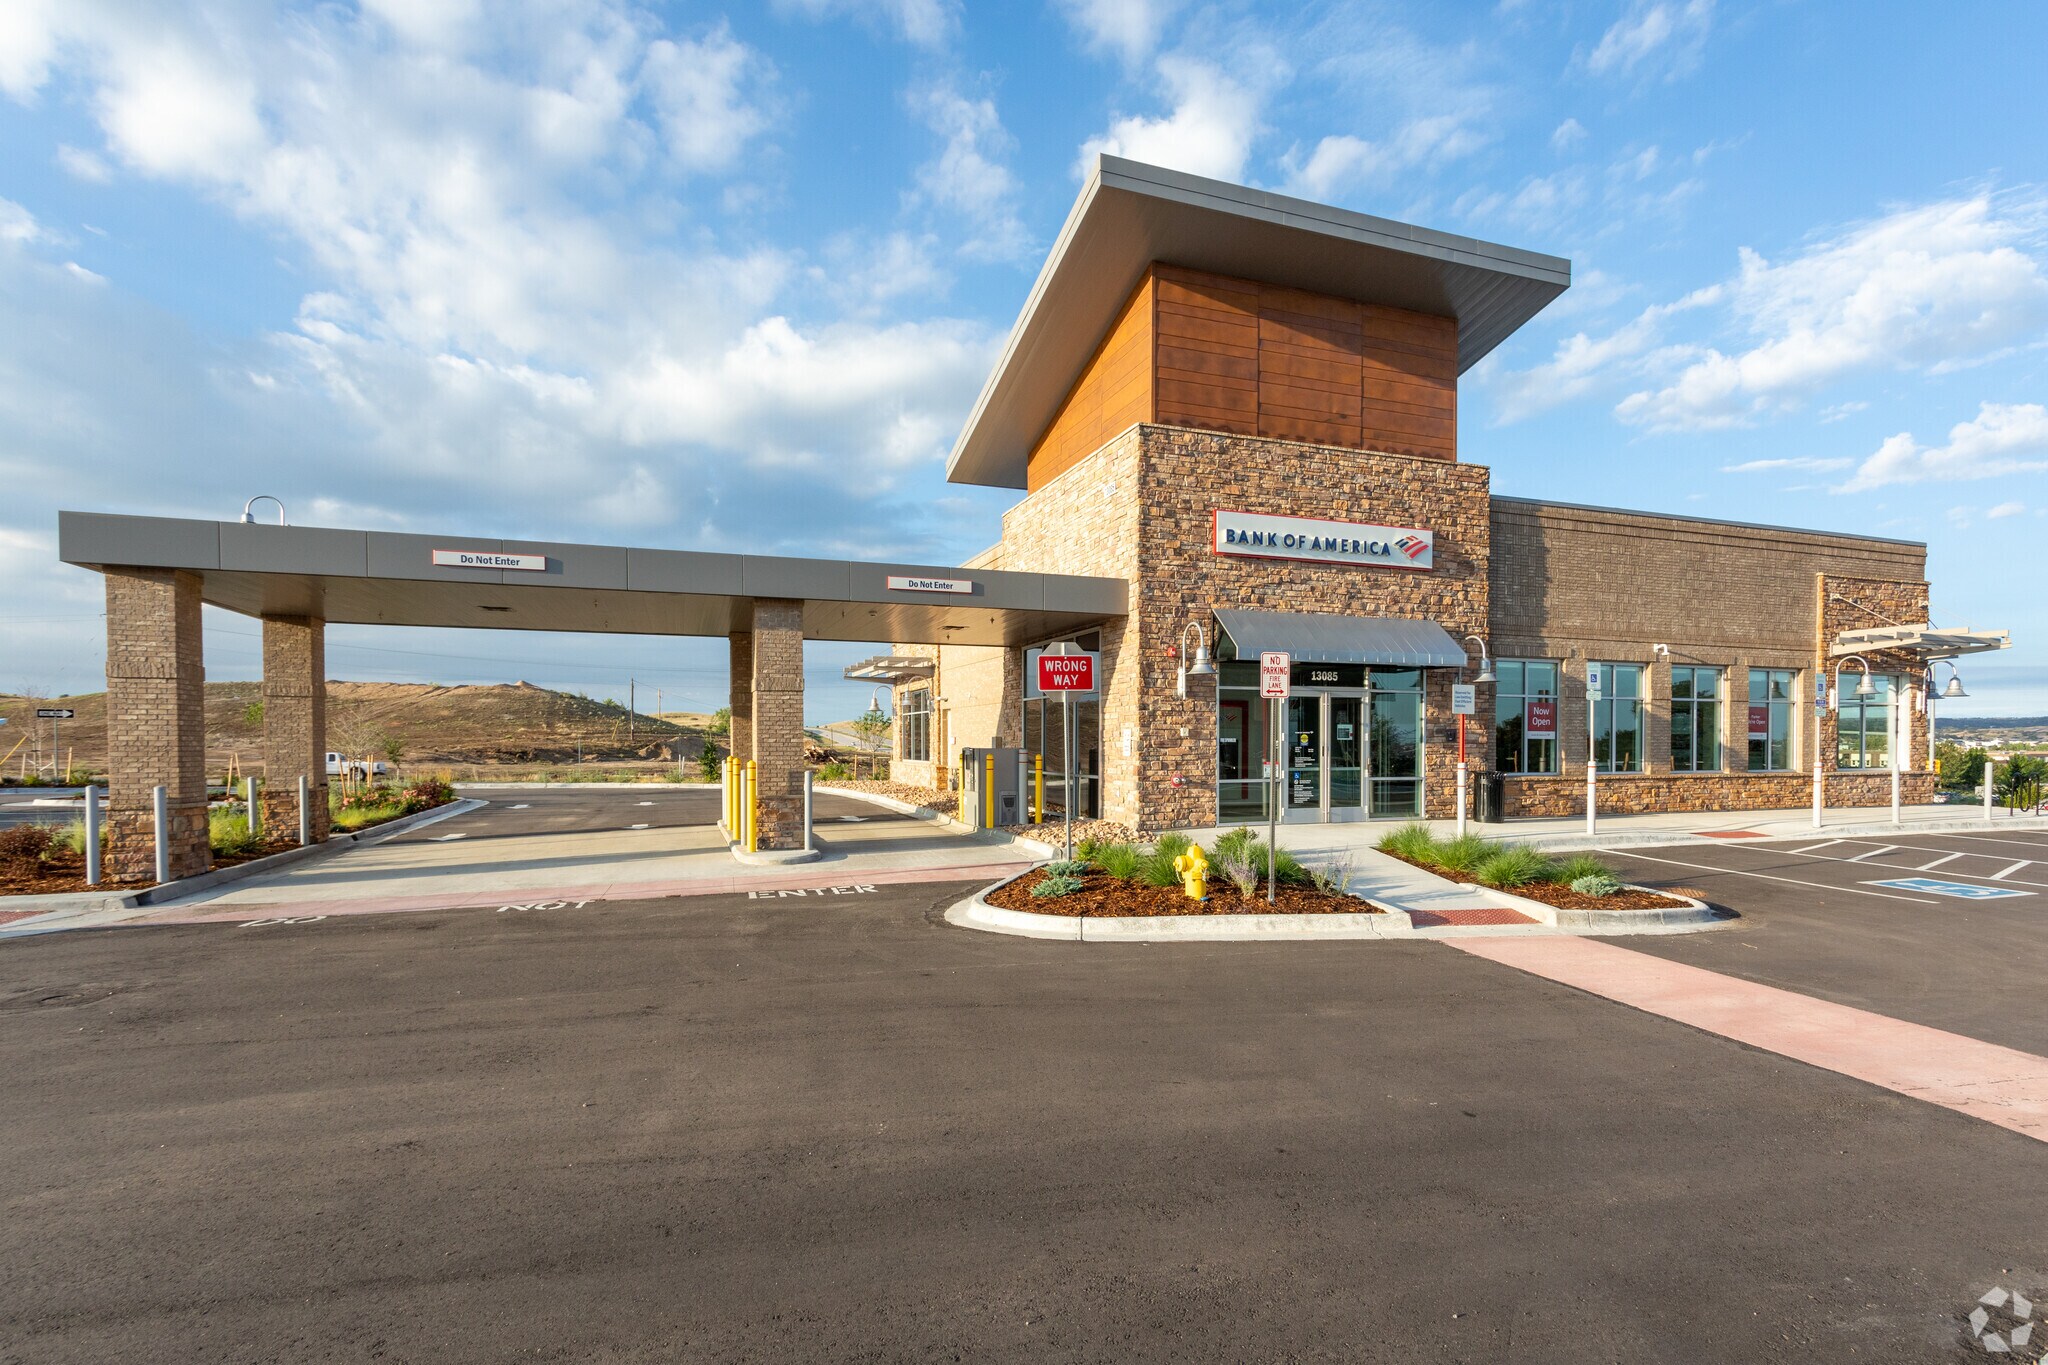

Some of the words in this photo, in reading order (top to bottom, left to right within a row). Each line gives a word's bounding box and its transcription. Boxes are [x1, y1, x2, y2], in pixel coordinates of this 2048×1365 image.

[1226, 528, 1277, 546] BANK
[1284, 533, 1306, 549] OF
[1312, 536, 1391, 556] AMERICA
[460, 554, 473, 563] Do
[476, 555, 492, 565] Not
[495, 556, 520, 566] Enter
[908, 580, 918, 588] Do
[920, 580, 933, 589] Not
[934, 581, 953, 590] Enter
[1044, 660, 1088, 672] WRONG
[1269, 656, 1281, 665] NO
[1263, 666, 1288, 676] PARKING
[1311, 670, 1338, 682] 13085
[1053, 674, 1079, 686] WAY
[1533, 706, 1550, 715] Now
[1532, 716, 1551, 727] Open
[747, 884, 879, 899] ENTER
[496, 900, 596, 912] NOT
[237, 915, 328, 927] DO
